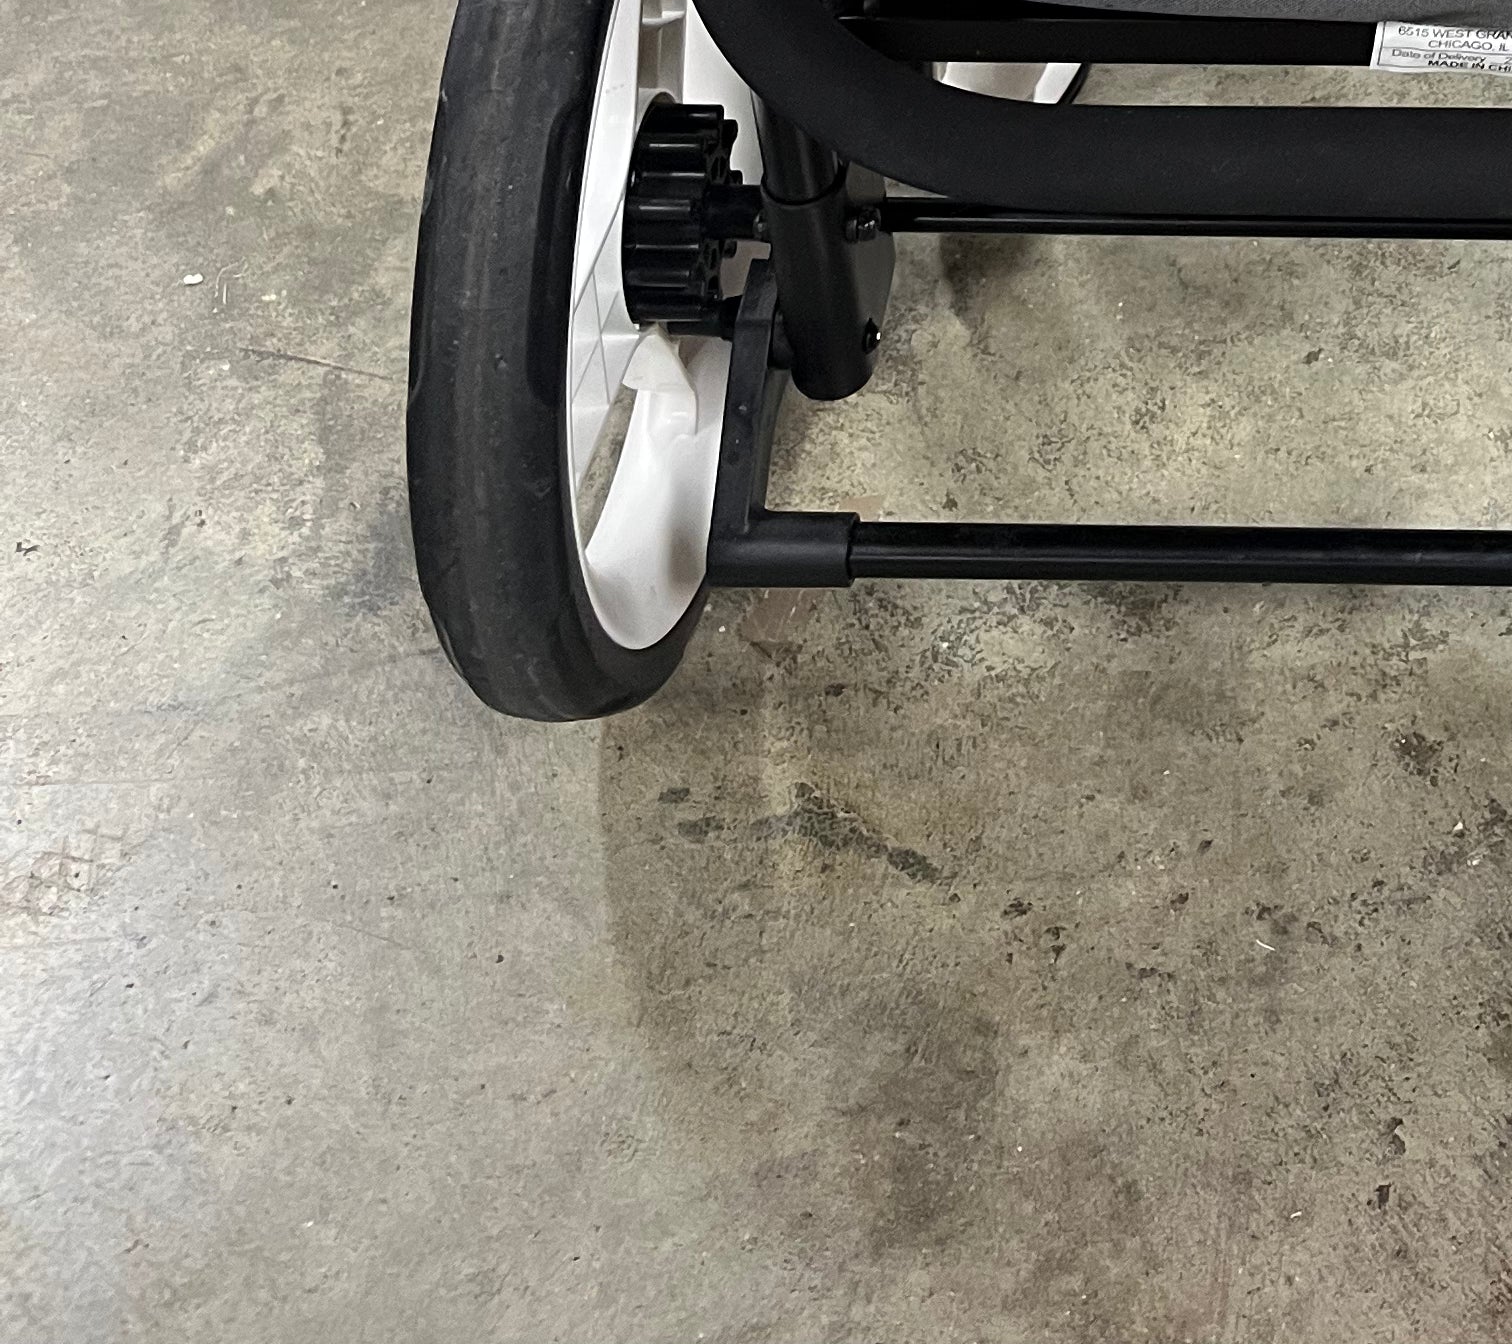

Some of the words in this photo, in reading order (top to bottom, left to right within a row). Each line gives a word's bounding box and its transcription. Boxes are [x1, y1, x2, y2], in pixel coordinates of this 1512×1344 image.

[1398, 25, 1429, 37] 6515
[1432, 28, 1473, 39] WEST
[1499, 44, 1509, 52] IL
[1392, 49, 1421, 59] Date
[1438, 52, 1487, 63] Delivery
[1428, 60, 1468, 69] MADE
[1472, 62, 1485, 70] IN
